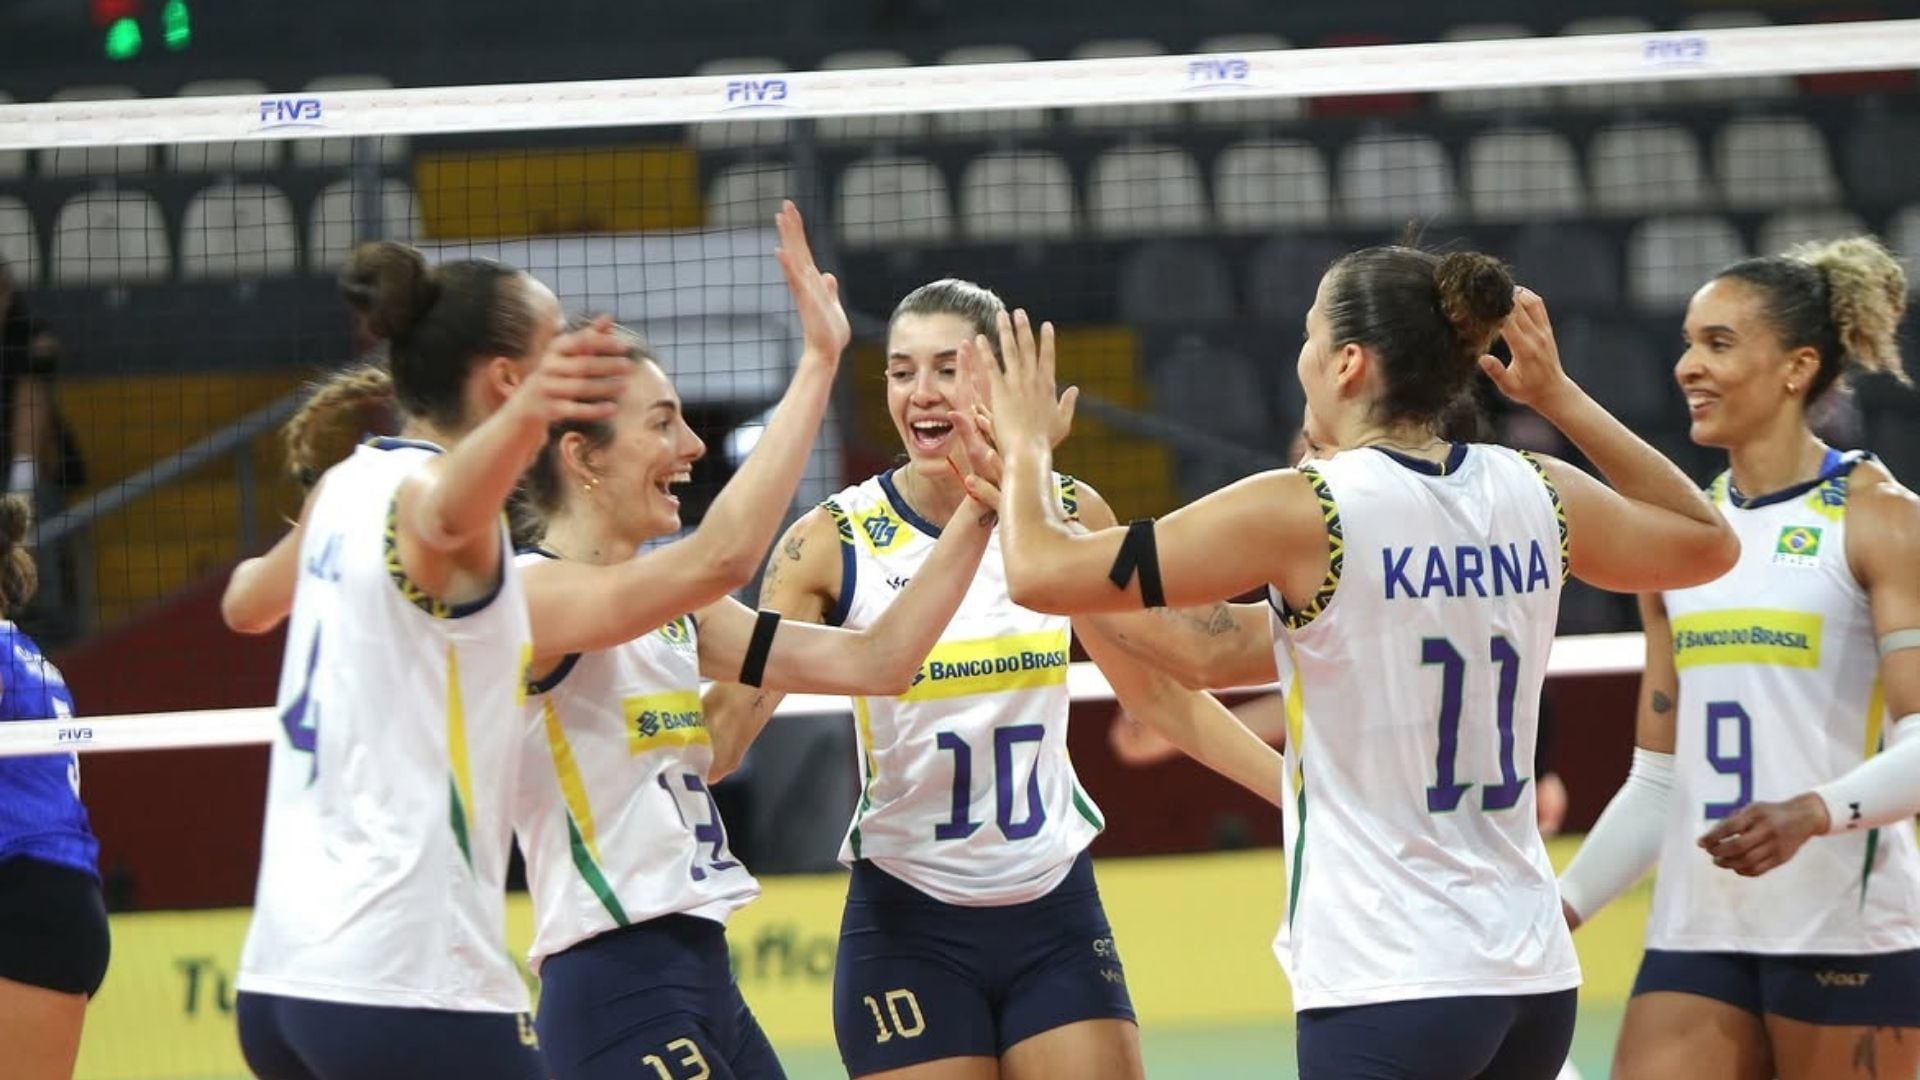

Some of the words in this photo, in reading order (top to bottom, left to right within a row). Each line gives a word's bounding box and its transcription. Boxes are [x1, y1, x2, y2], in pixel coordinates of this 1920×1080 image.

[727, 80, 787, 101] FIVB
[1188, 59, 1249, 80] FIVB
[260, 100, 321, 121] FIVB
[1382, 539, 1550, 600] KARNA
[930, 660, 993, 681] BANCO
[995, 656, 1019, 673] DO
[58, 728, 93, 740] FIVB
[1421, 635, 1530, 813] 11
[1705, 701, 1752, 819] 9
[936, 724, 1046, 841] 10
[864, 988, 925, 1043] 10
[642, 1038, 711, 1080] 13
